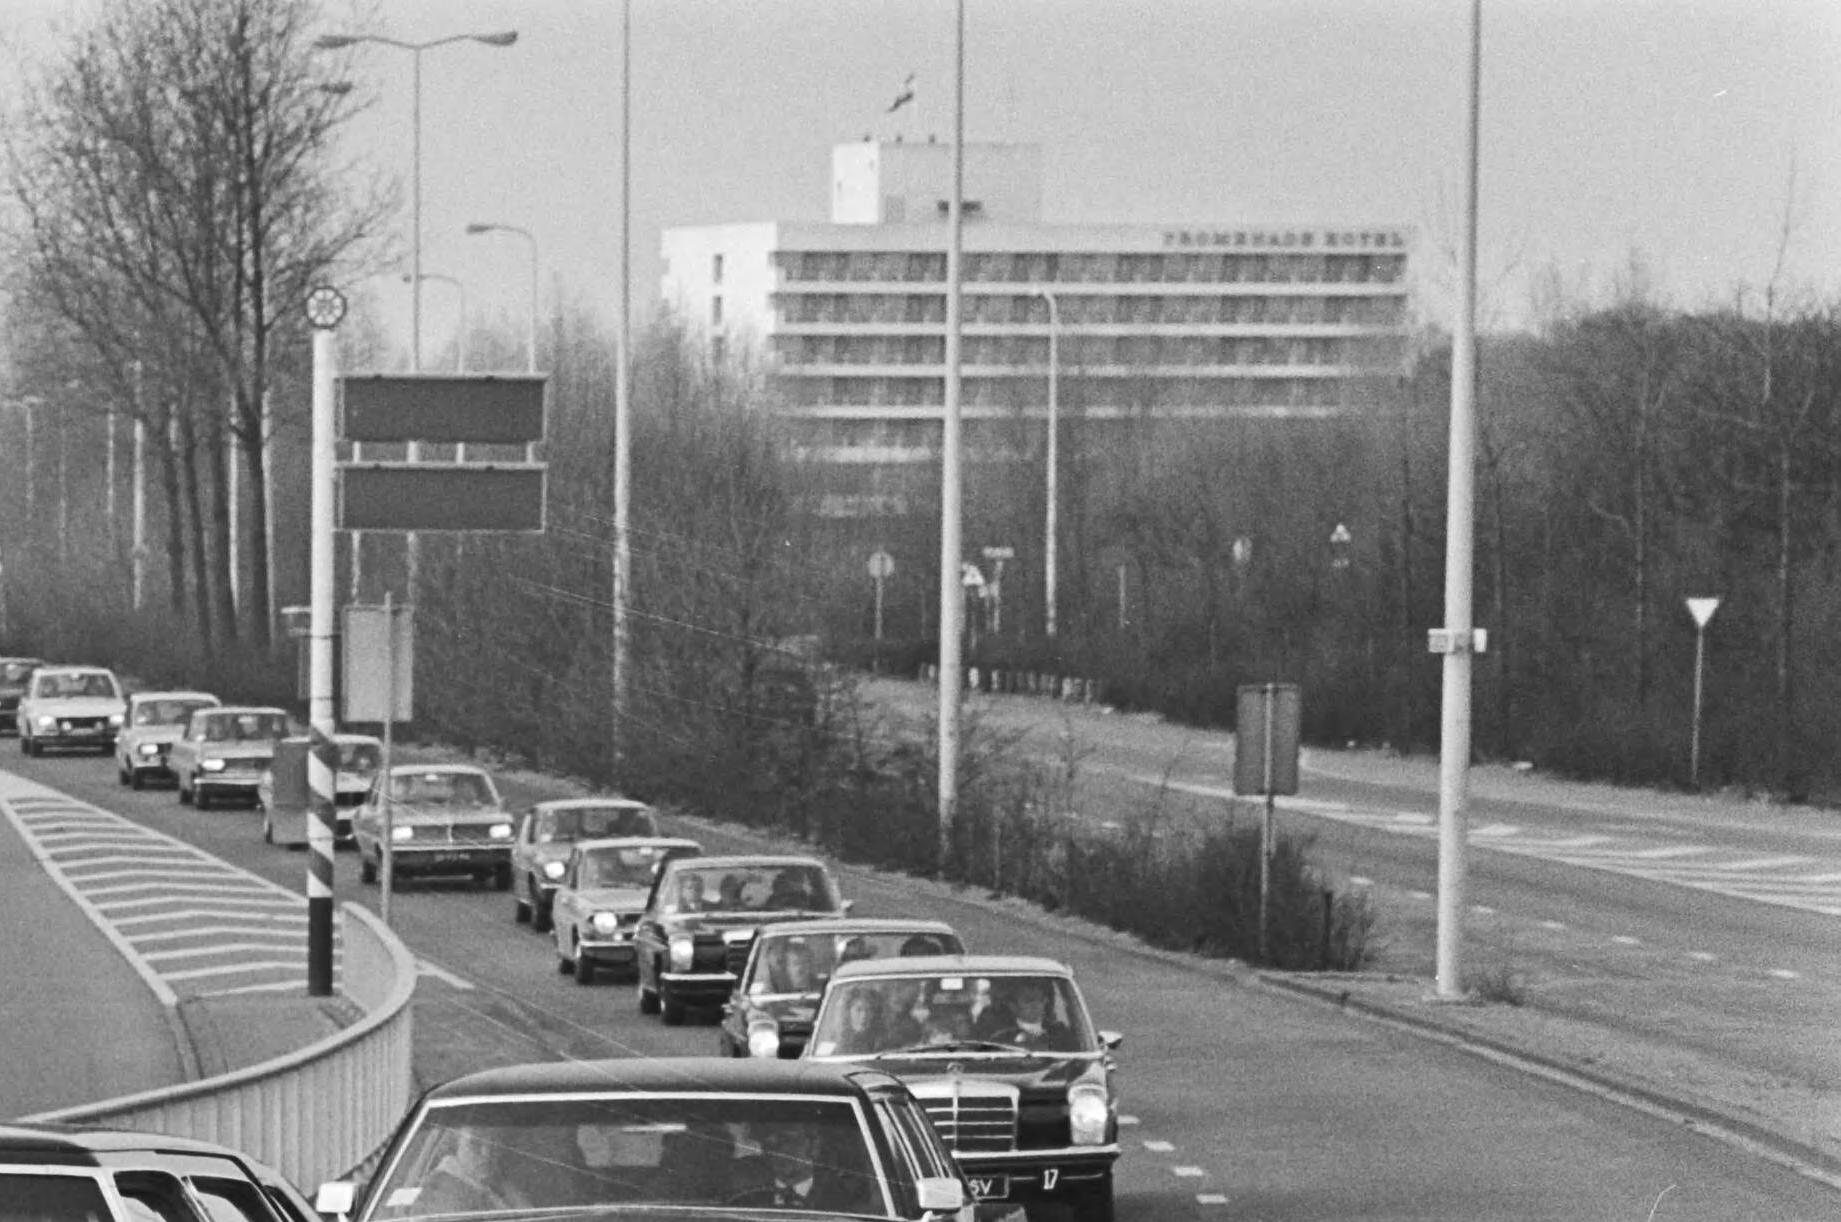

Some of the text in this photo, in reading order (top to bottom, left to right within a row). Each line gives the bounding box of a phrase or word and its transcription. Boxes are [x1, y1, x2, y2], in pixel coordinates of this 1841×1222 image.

[1163, 231, 1405, 247] PROMENADE HOTEL
[1043, 1168, 1059, 1190] 17
